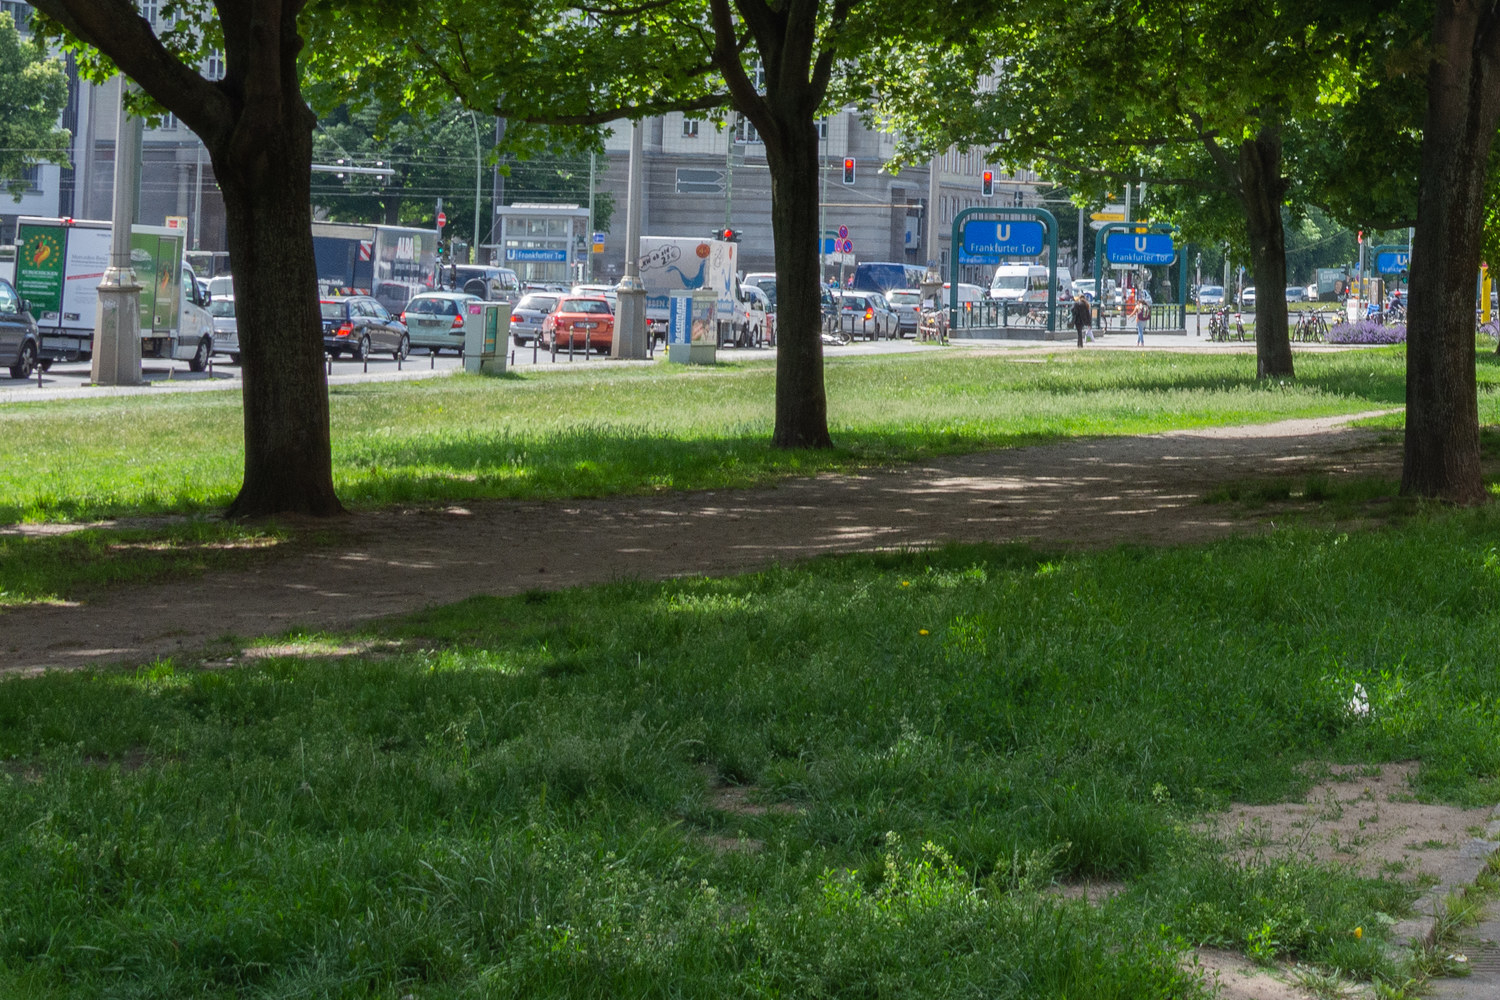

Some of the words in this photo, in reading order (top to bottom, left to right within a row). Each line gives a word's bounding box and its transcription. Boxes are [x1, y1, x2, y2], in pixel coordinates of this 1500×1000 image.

[997, 223, 1011, 241] U
[396, 236, 414, 259] ALBA
[970, 243, 1018, 253] Frankfurter
[1022, 244, 1035, 253] Tor
[1134, 236, 1147, 252] U
[507, 249, 516, 260] U
[518, 250, 553, 259] Frankfurter
[555, 251, 565, 259] Tor
[1112, 252, 1153, 262] Frankfurter
[1156, 254, 1168, 262] Tor
